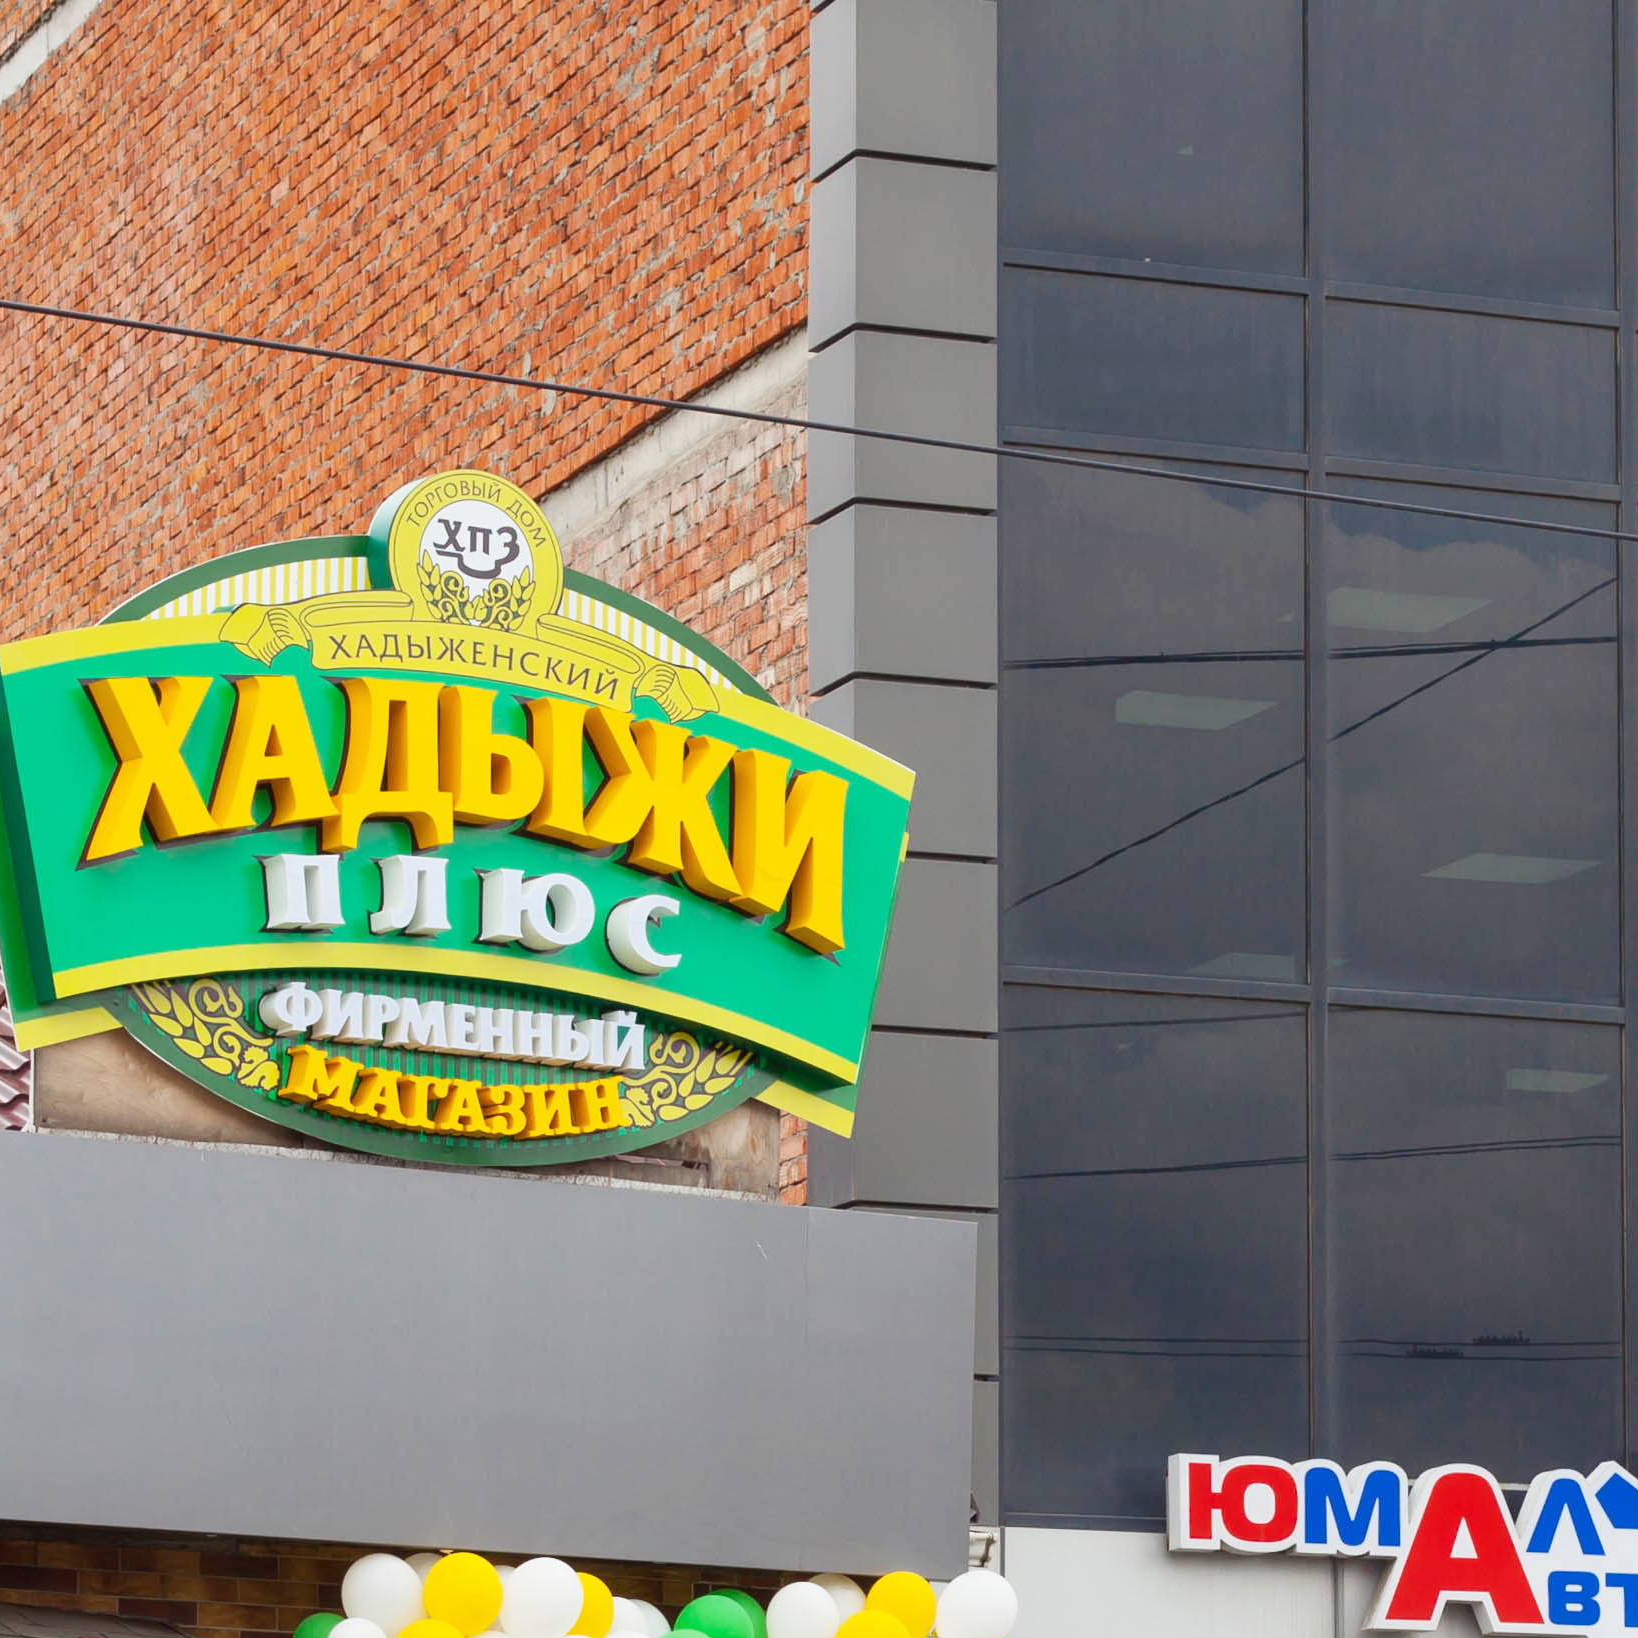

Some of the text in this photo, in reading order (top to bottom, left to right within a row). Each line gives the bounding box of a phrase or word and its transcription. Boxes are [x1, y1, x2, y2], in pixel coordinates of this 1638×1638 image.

[406, 480, 547, 548] ТОРГОВЫЙ ДОМ
[327, 628, 623, 702] ХАДЫЖЕНСКИЙ
[78, 675, 849, 956] ХАДЫЖИ
[264, 852, 682, 974] ПЛЮС
[260, 981, 647, 1071] ФИРМЕННЫЙ
[279, 1044, 629, 1139] МАГАЗИН
